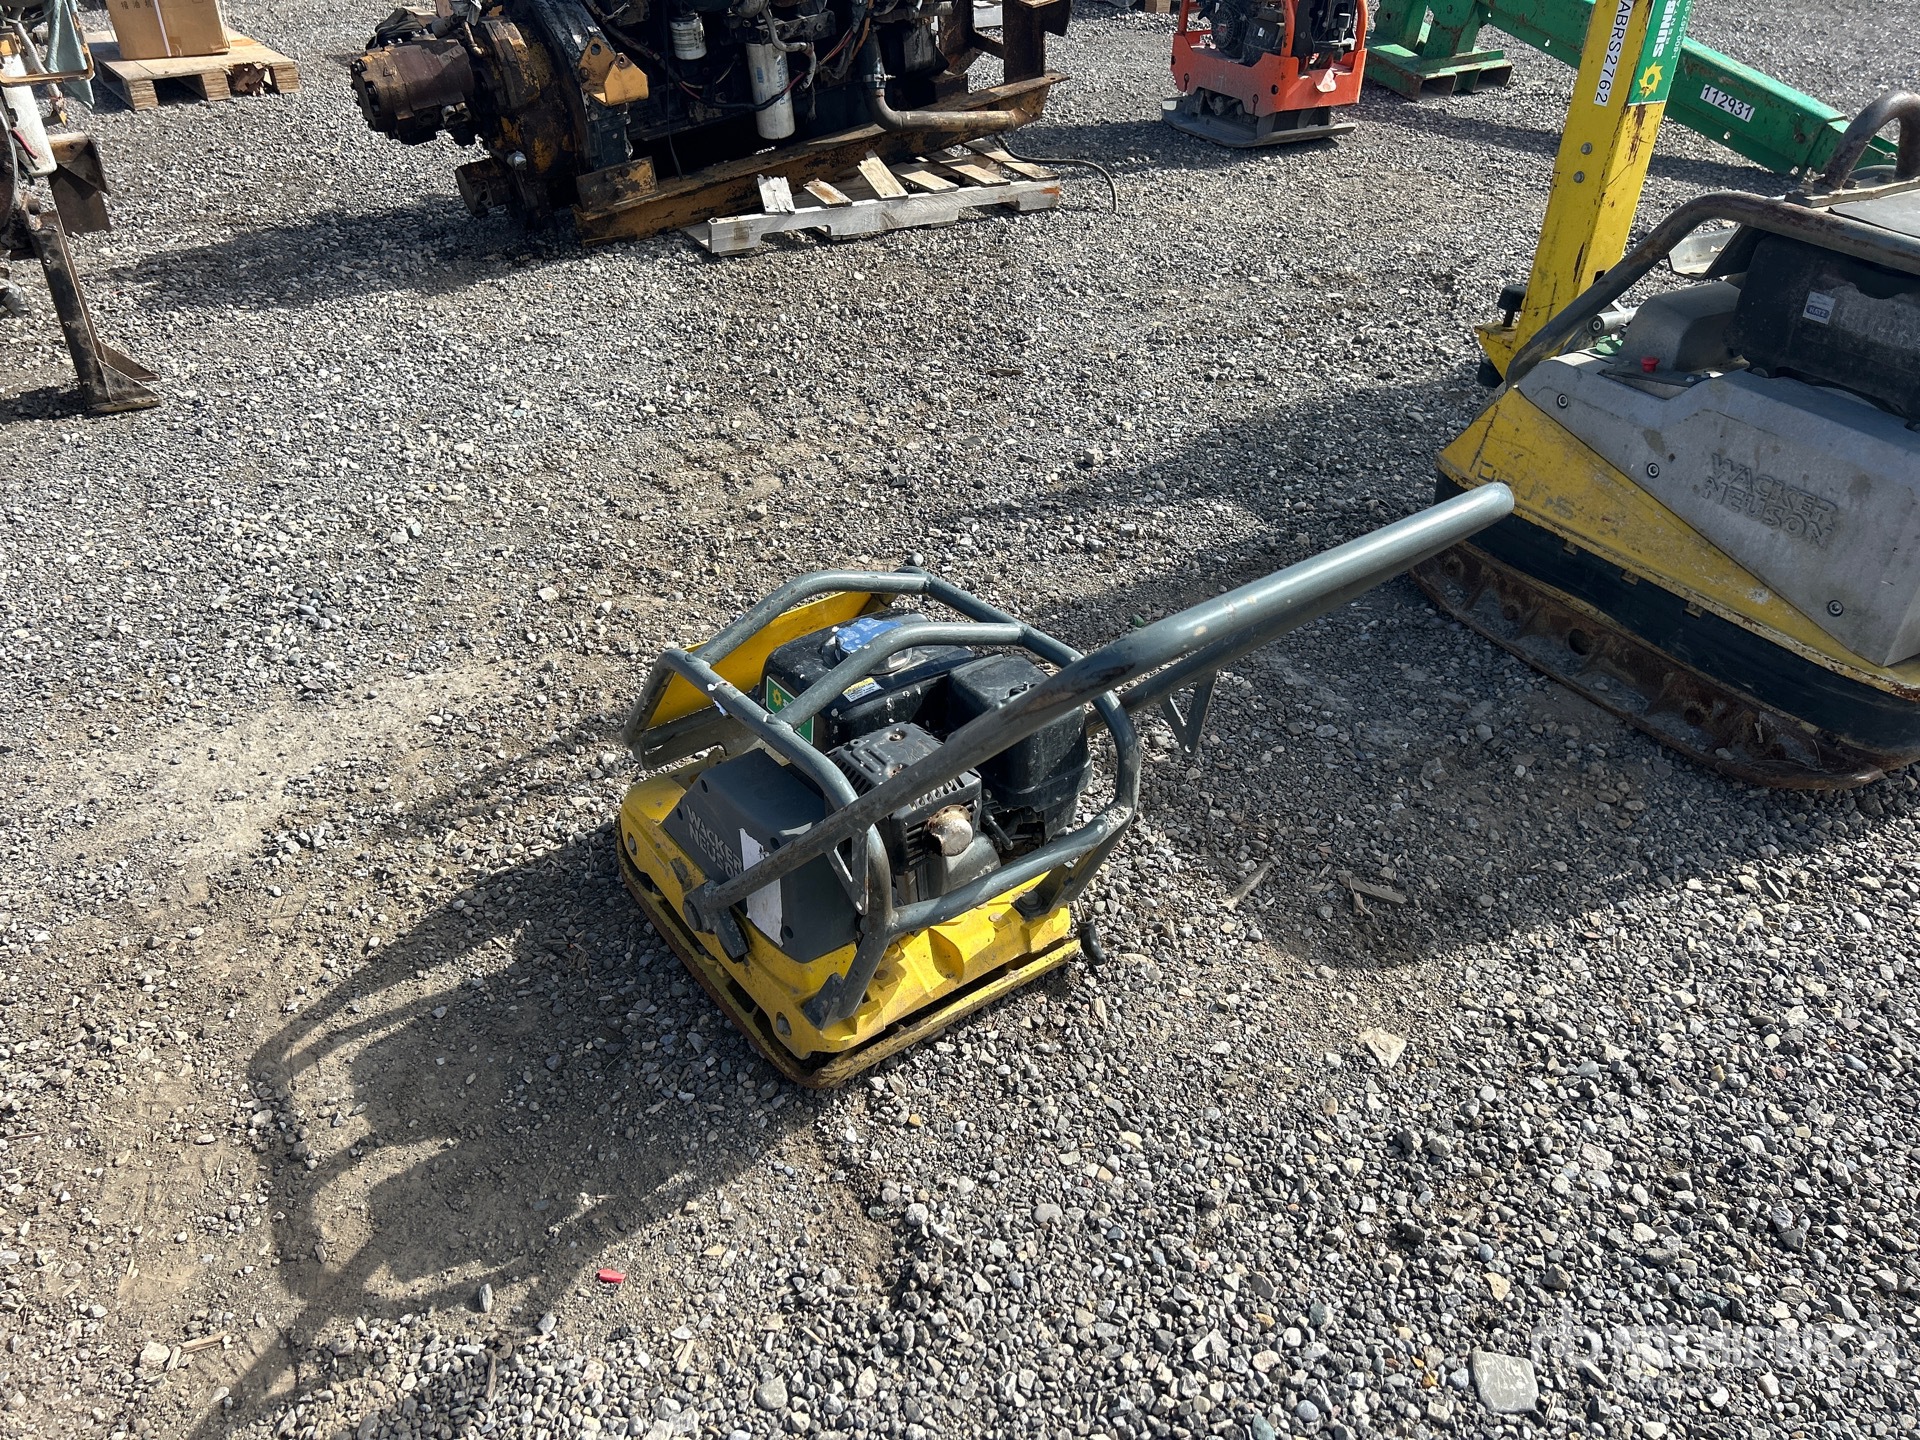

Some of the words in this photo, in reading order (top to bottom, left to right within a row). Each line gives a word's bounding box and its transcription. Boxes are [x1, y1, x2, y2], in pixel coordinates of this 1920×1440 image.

[1595, 1, 1631, 103] ABRS2762
[1704, 86, 1753, 120] 112931
[1702, 475, 1830, 551] NEUSON
[1711, 452, 1839, 534] WACKER
[686, 804, 744, 874] WACKER
